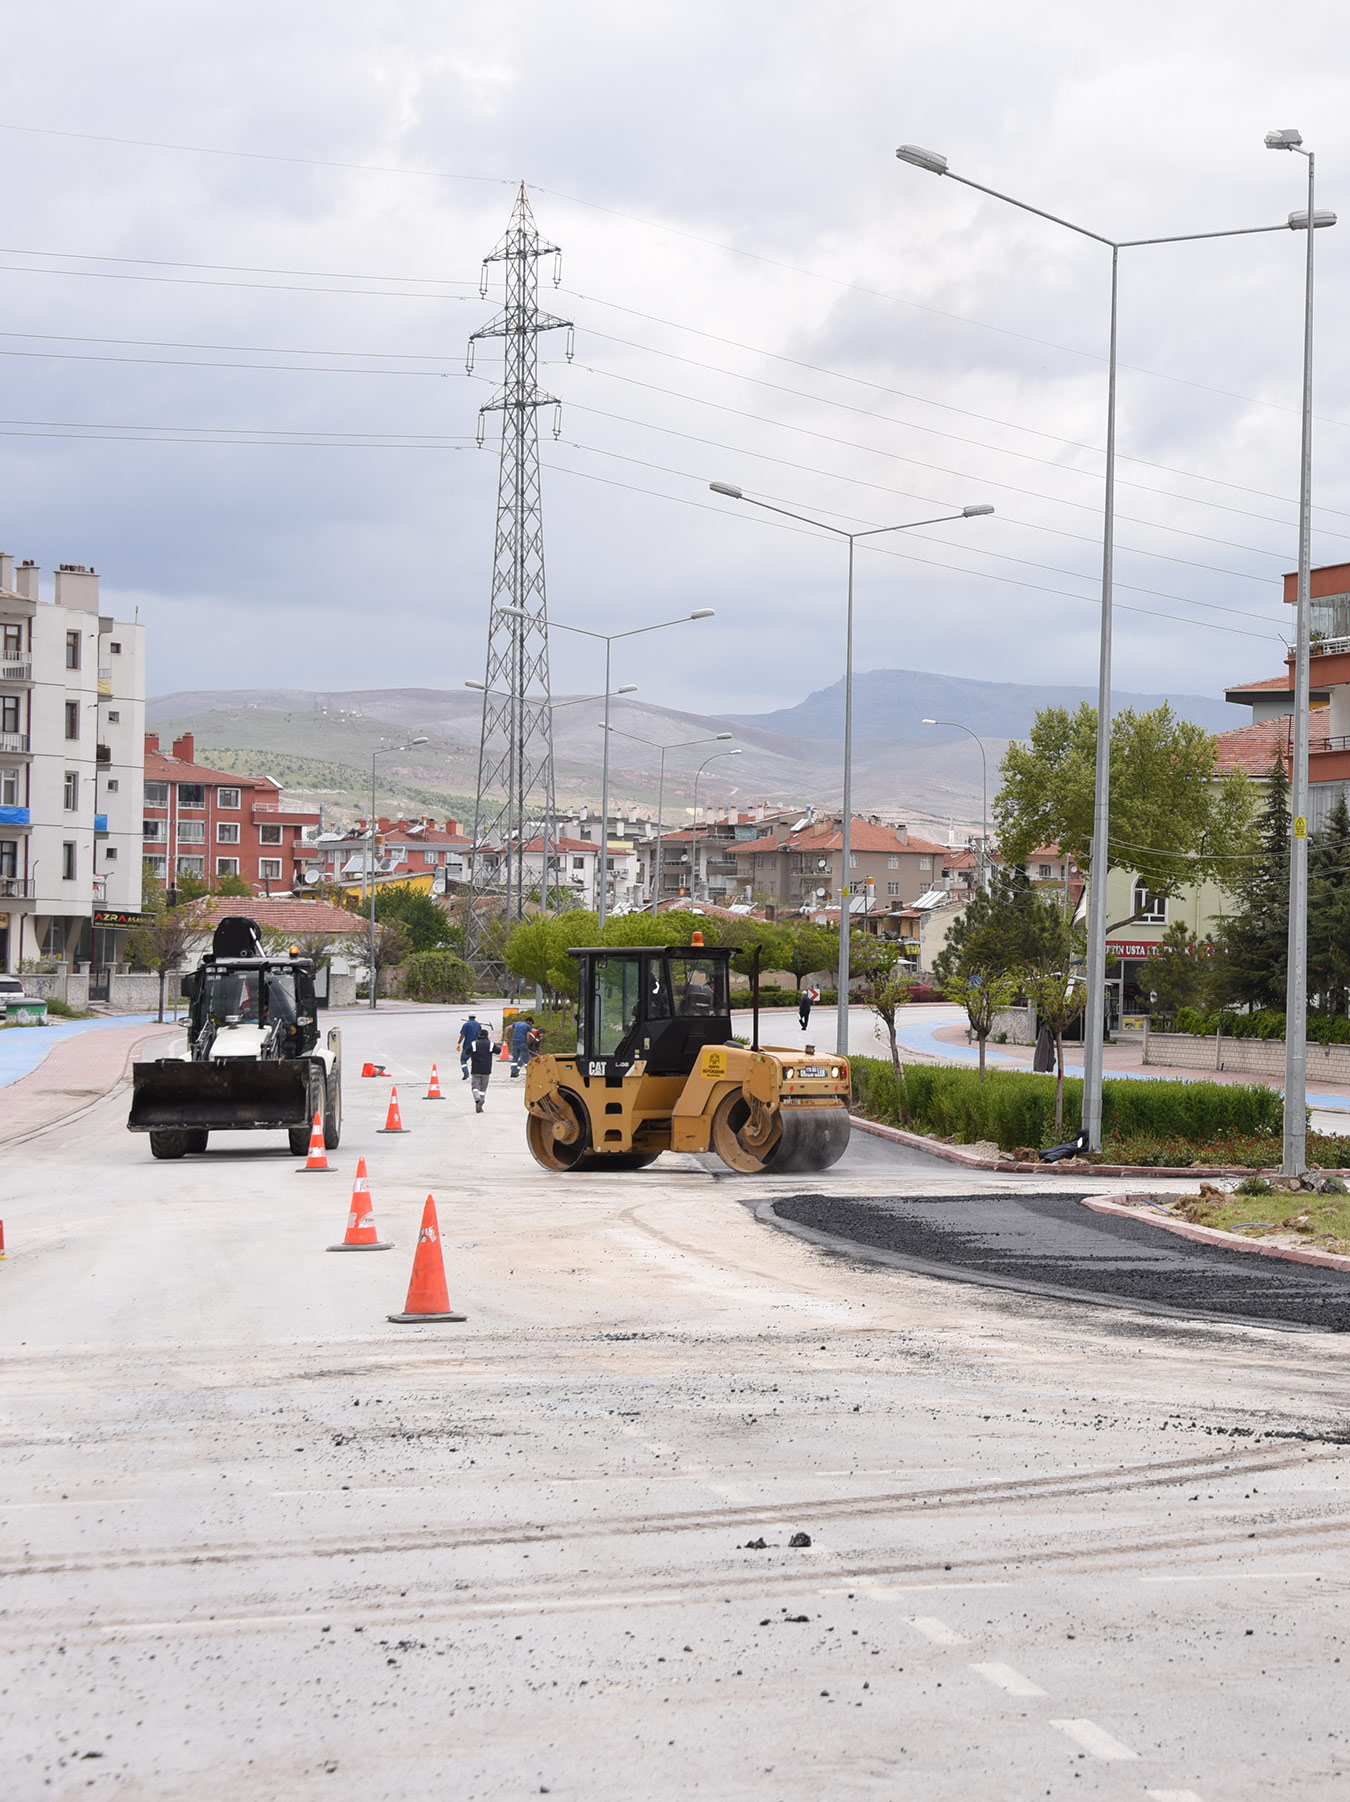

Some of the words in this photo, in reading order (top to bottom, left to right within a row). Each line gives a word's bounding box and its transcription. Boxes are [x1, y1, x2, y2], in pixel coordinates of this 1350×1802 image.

[94, 912, 127, 922] AZRA
[1126, 945, 1145, 955] USTA
[589, 1061, 607, 1076] CAT
